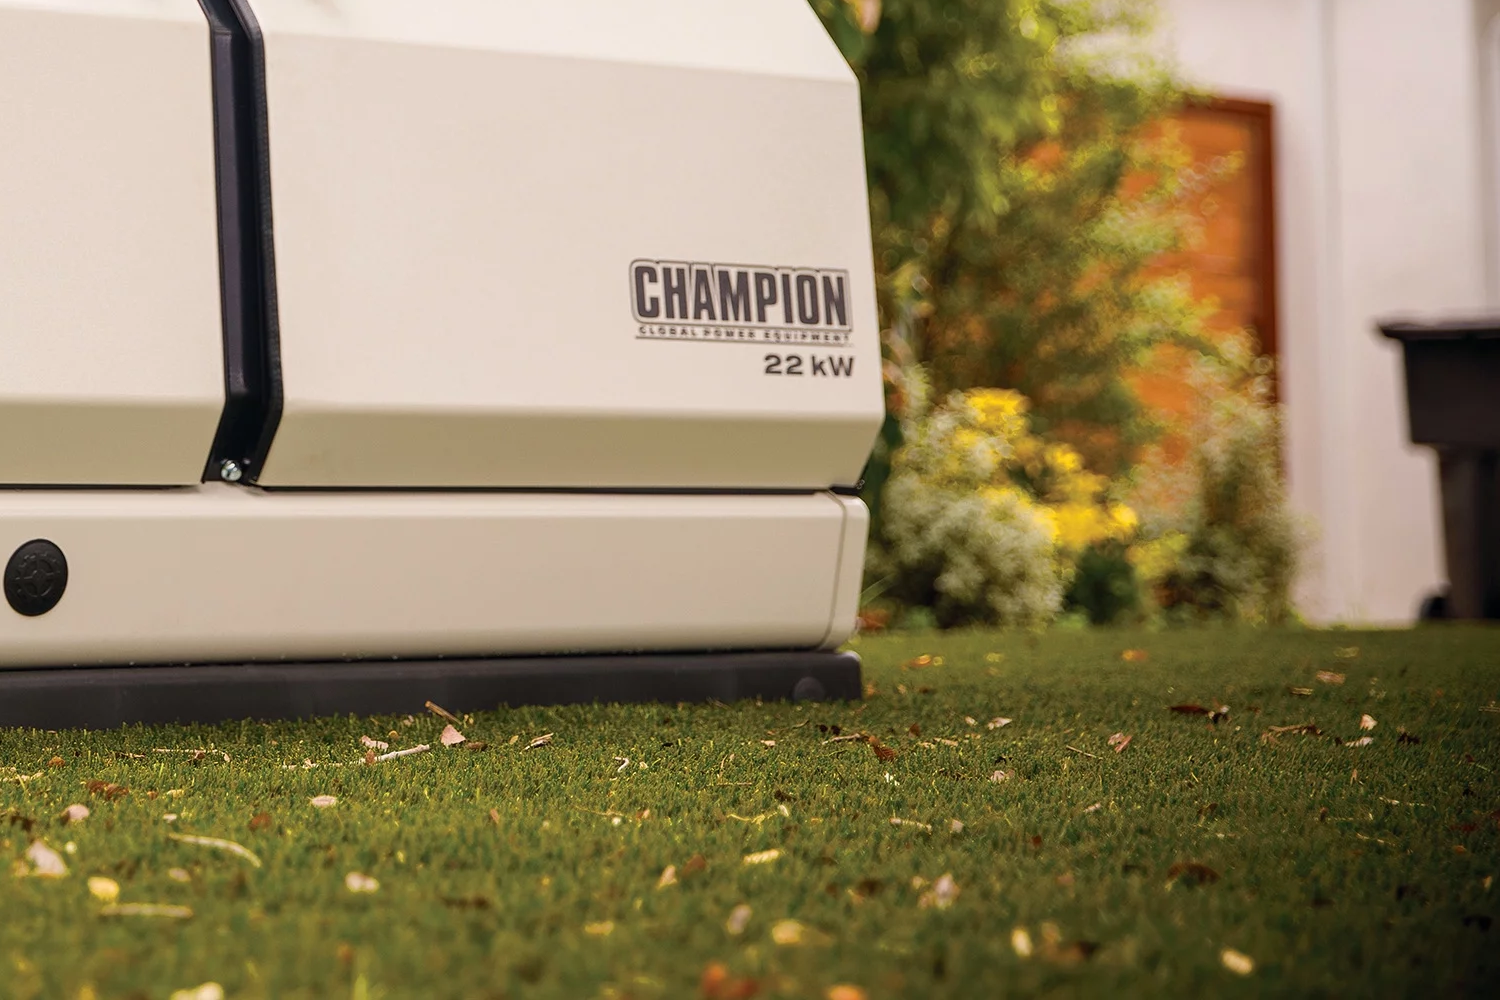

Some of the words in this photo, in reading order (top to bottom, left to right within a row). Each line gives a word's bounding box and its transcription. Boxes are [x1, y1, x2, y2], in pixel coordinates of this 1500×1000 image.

[634, 265, 847, 326] CHAMPION
[638, 325, 697, 336] GLOBAL
[703, 329, 755, 339] POWER
[763, 331, 849, 342] EQUIPMENT
[764, 354, 804, 375] 22
[811, 355, 854, 377] kW
